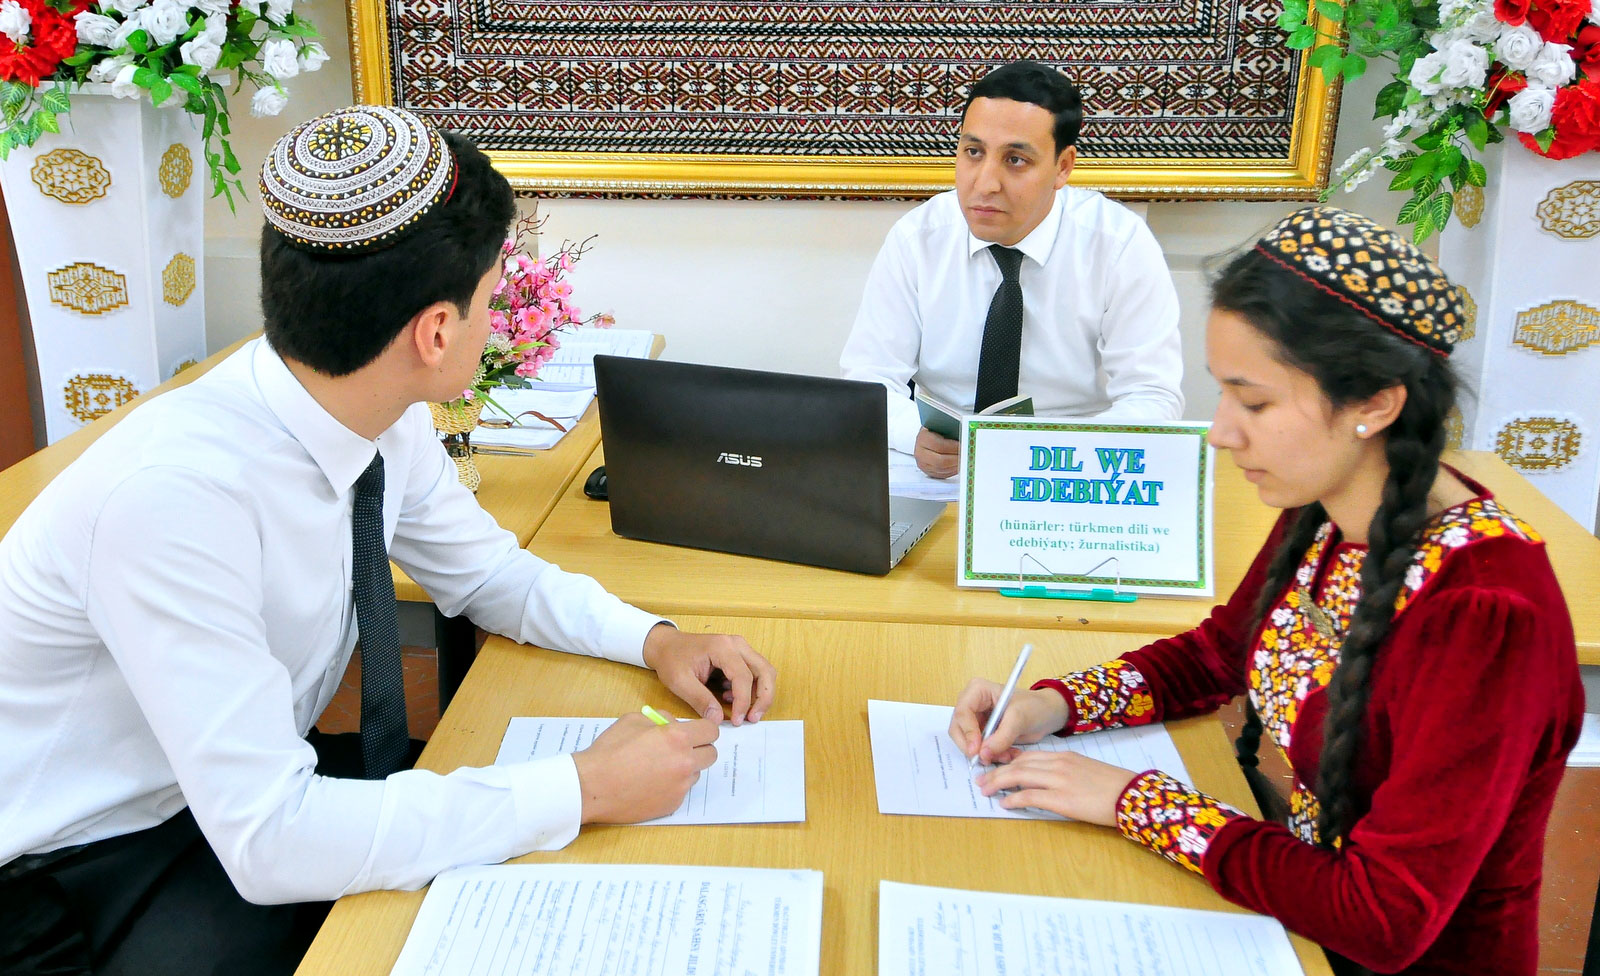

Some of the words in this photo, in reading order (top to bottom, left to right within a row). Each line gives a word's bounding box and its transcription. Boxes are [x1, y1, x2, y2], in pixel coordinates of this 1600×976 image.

[717, 452, 762, 468] ASUS
[1029, 446, 1083, 472] DIL
[1095, 447, 1145, 473] WE
[1010, 473, 1163, 506] EDEBIÝAT
[1000, 519, 1065, 533] (hünärler:
[1069, 522, 1124, 535] türkmen
[1128, 523, 1148, 535] dili
[1153, 527, 1170, 536] we
